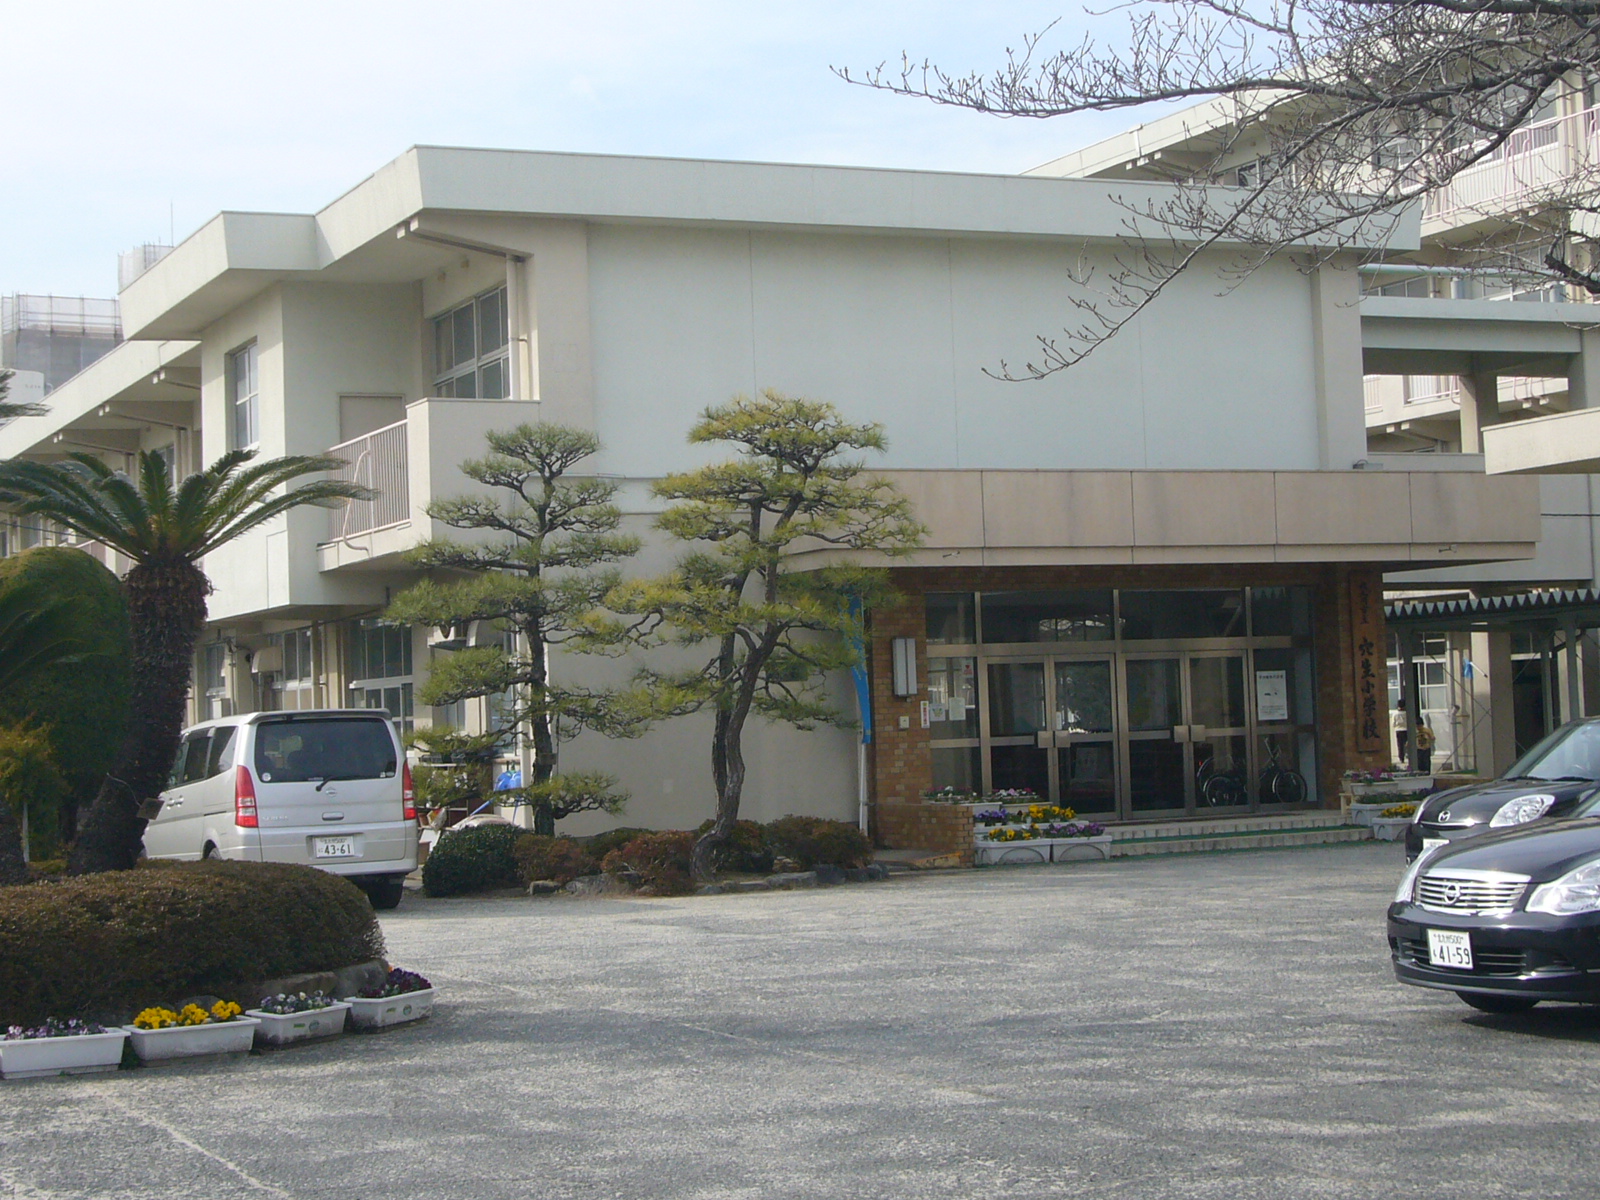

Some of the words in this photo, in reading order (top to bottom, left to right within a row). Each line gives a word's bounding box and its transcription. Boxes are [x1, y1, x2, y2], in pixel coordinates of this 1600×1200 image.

[1358, 637, 1381, 739] 穴生小学校
[1439, 946, 1471, 965] 41-59
